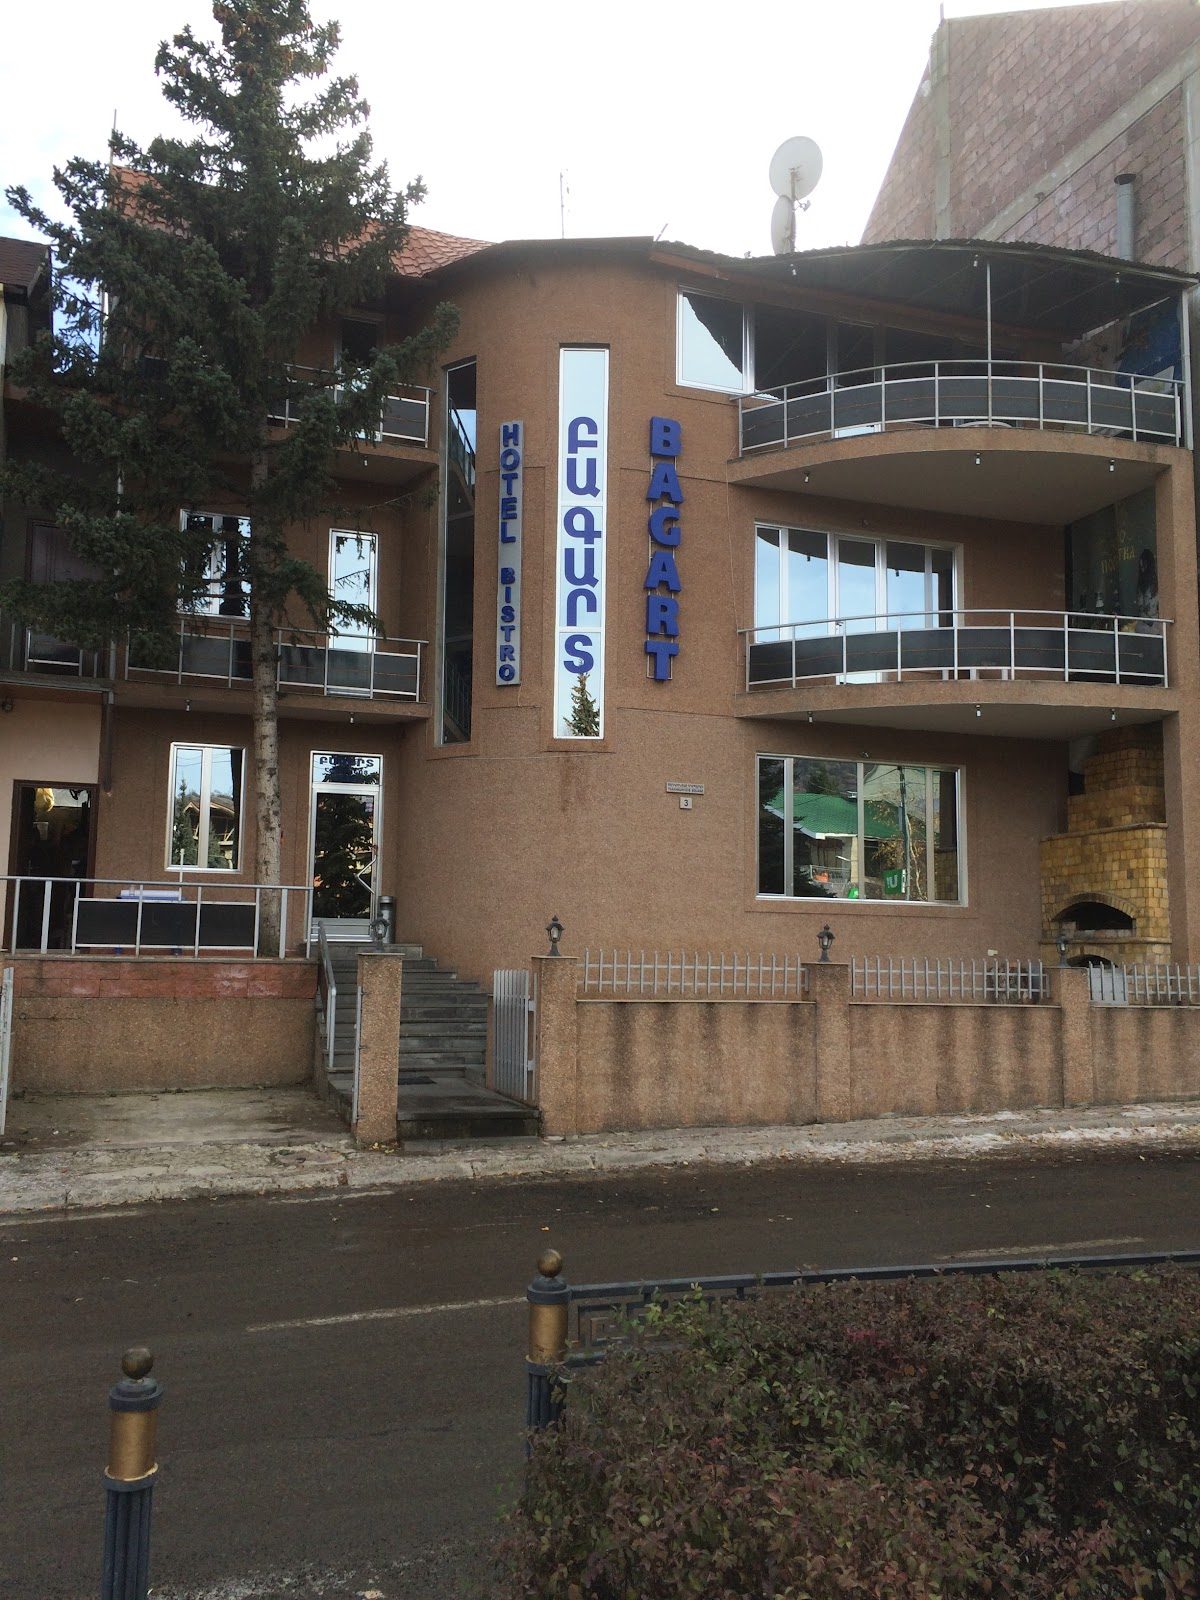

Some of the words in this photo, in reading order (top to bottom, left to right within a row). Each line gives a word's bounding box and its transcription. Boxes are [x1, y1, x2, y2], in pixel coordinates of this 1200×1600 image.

[500, 423, 520, 543] HOTEL
[563, 416, 602, 674] ԲԱԳԱՐՏ
[643, 416, 684, 681] BAGART
[499, 567, 516, 681] BISTRO
[319, 756, 375, 767] ԲԱՐՏ
[683, 799, 689, 807] 3
